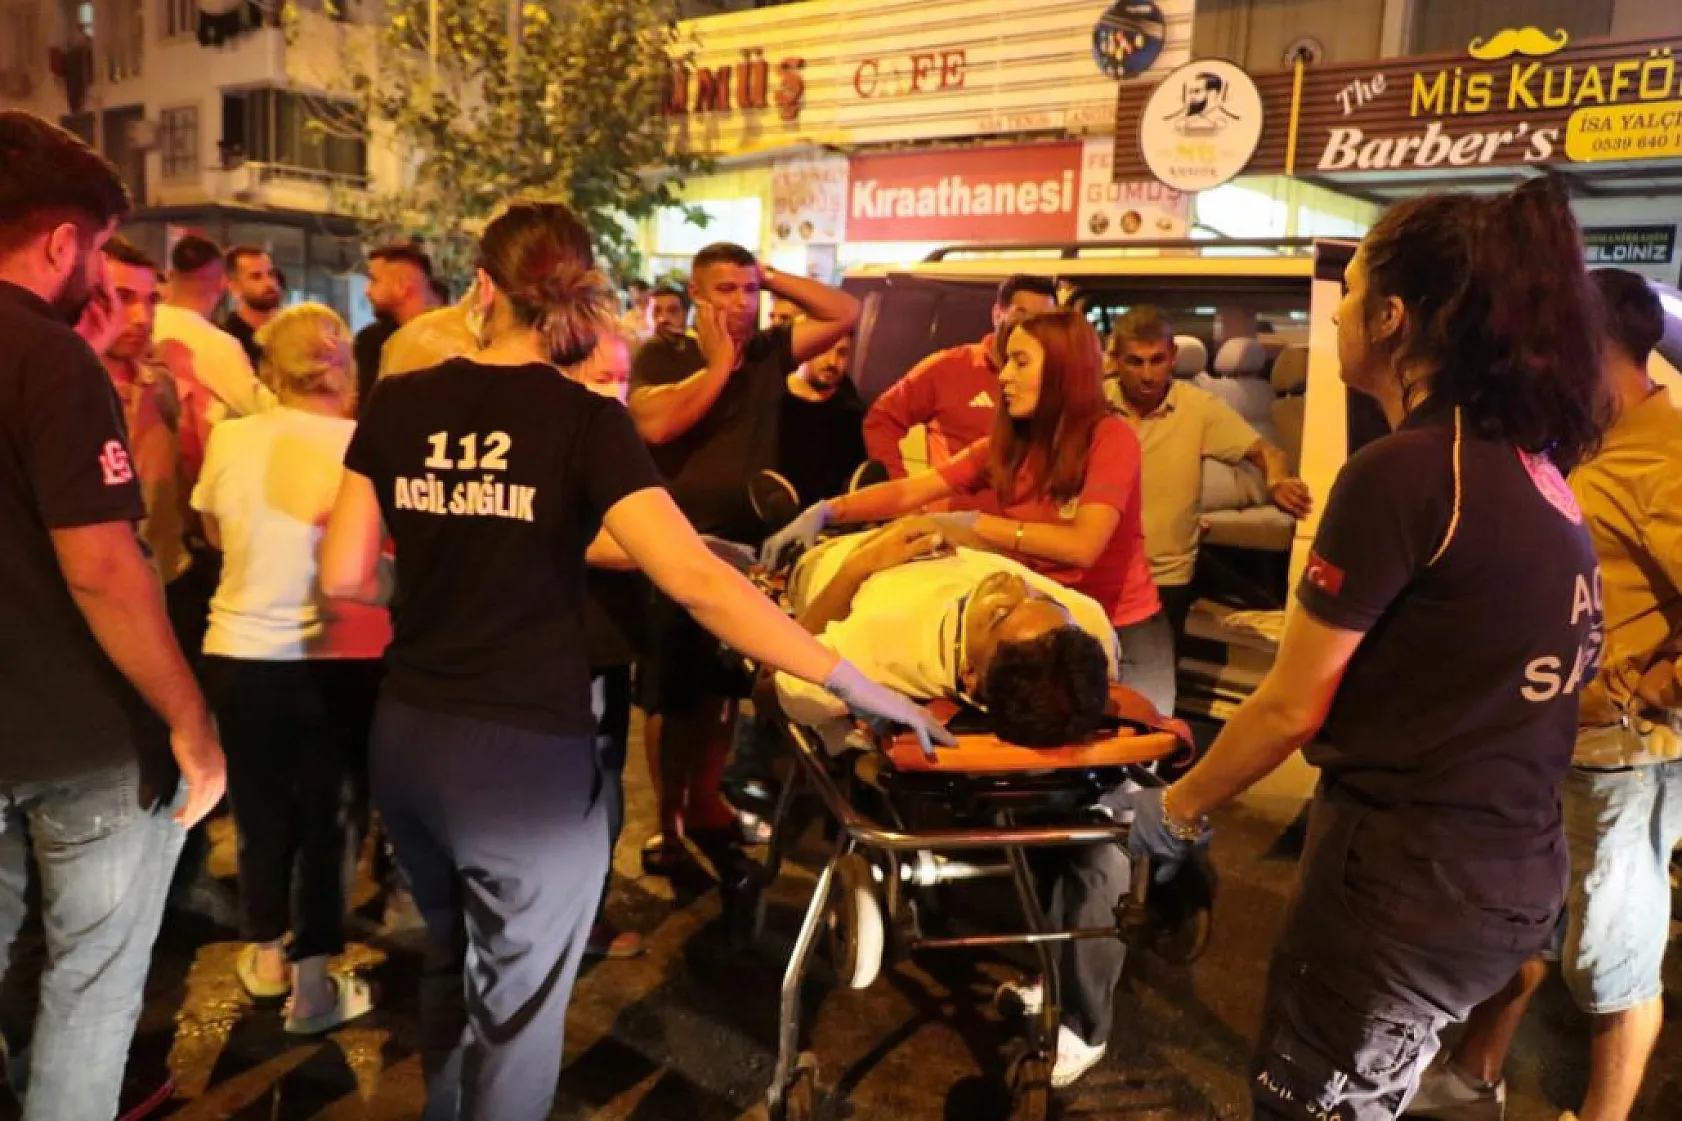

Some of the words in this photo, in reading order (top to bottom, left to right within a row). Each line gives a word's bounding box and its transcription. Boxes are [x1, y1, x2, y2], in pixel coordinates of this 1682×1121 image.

[660, 47, 806, 121] ÜMÜŞ
[1335, 72, 1387, 116] The
[1507, 47, 1682, 110] KUAFÖ
[1591, 137, 1632, 152] 0539
[1621, 109, 1682, 133] YALÇI
[852, 169, 1075, 219] Kıraathanesi
[424, 430, 512, 470] 112
[394, 472, 447, 514] ACİL
[449, 474, 537, 523] SAĞLIK
